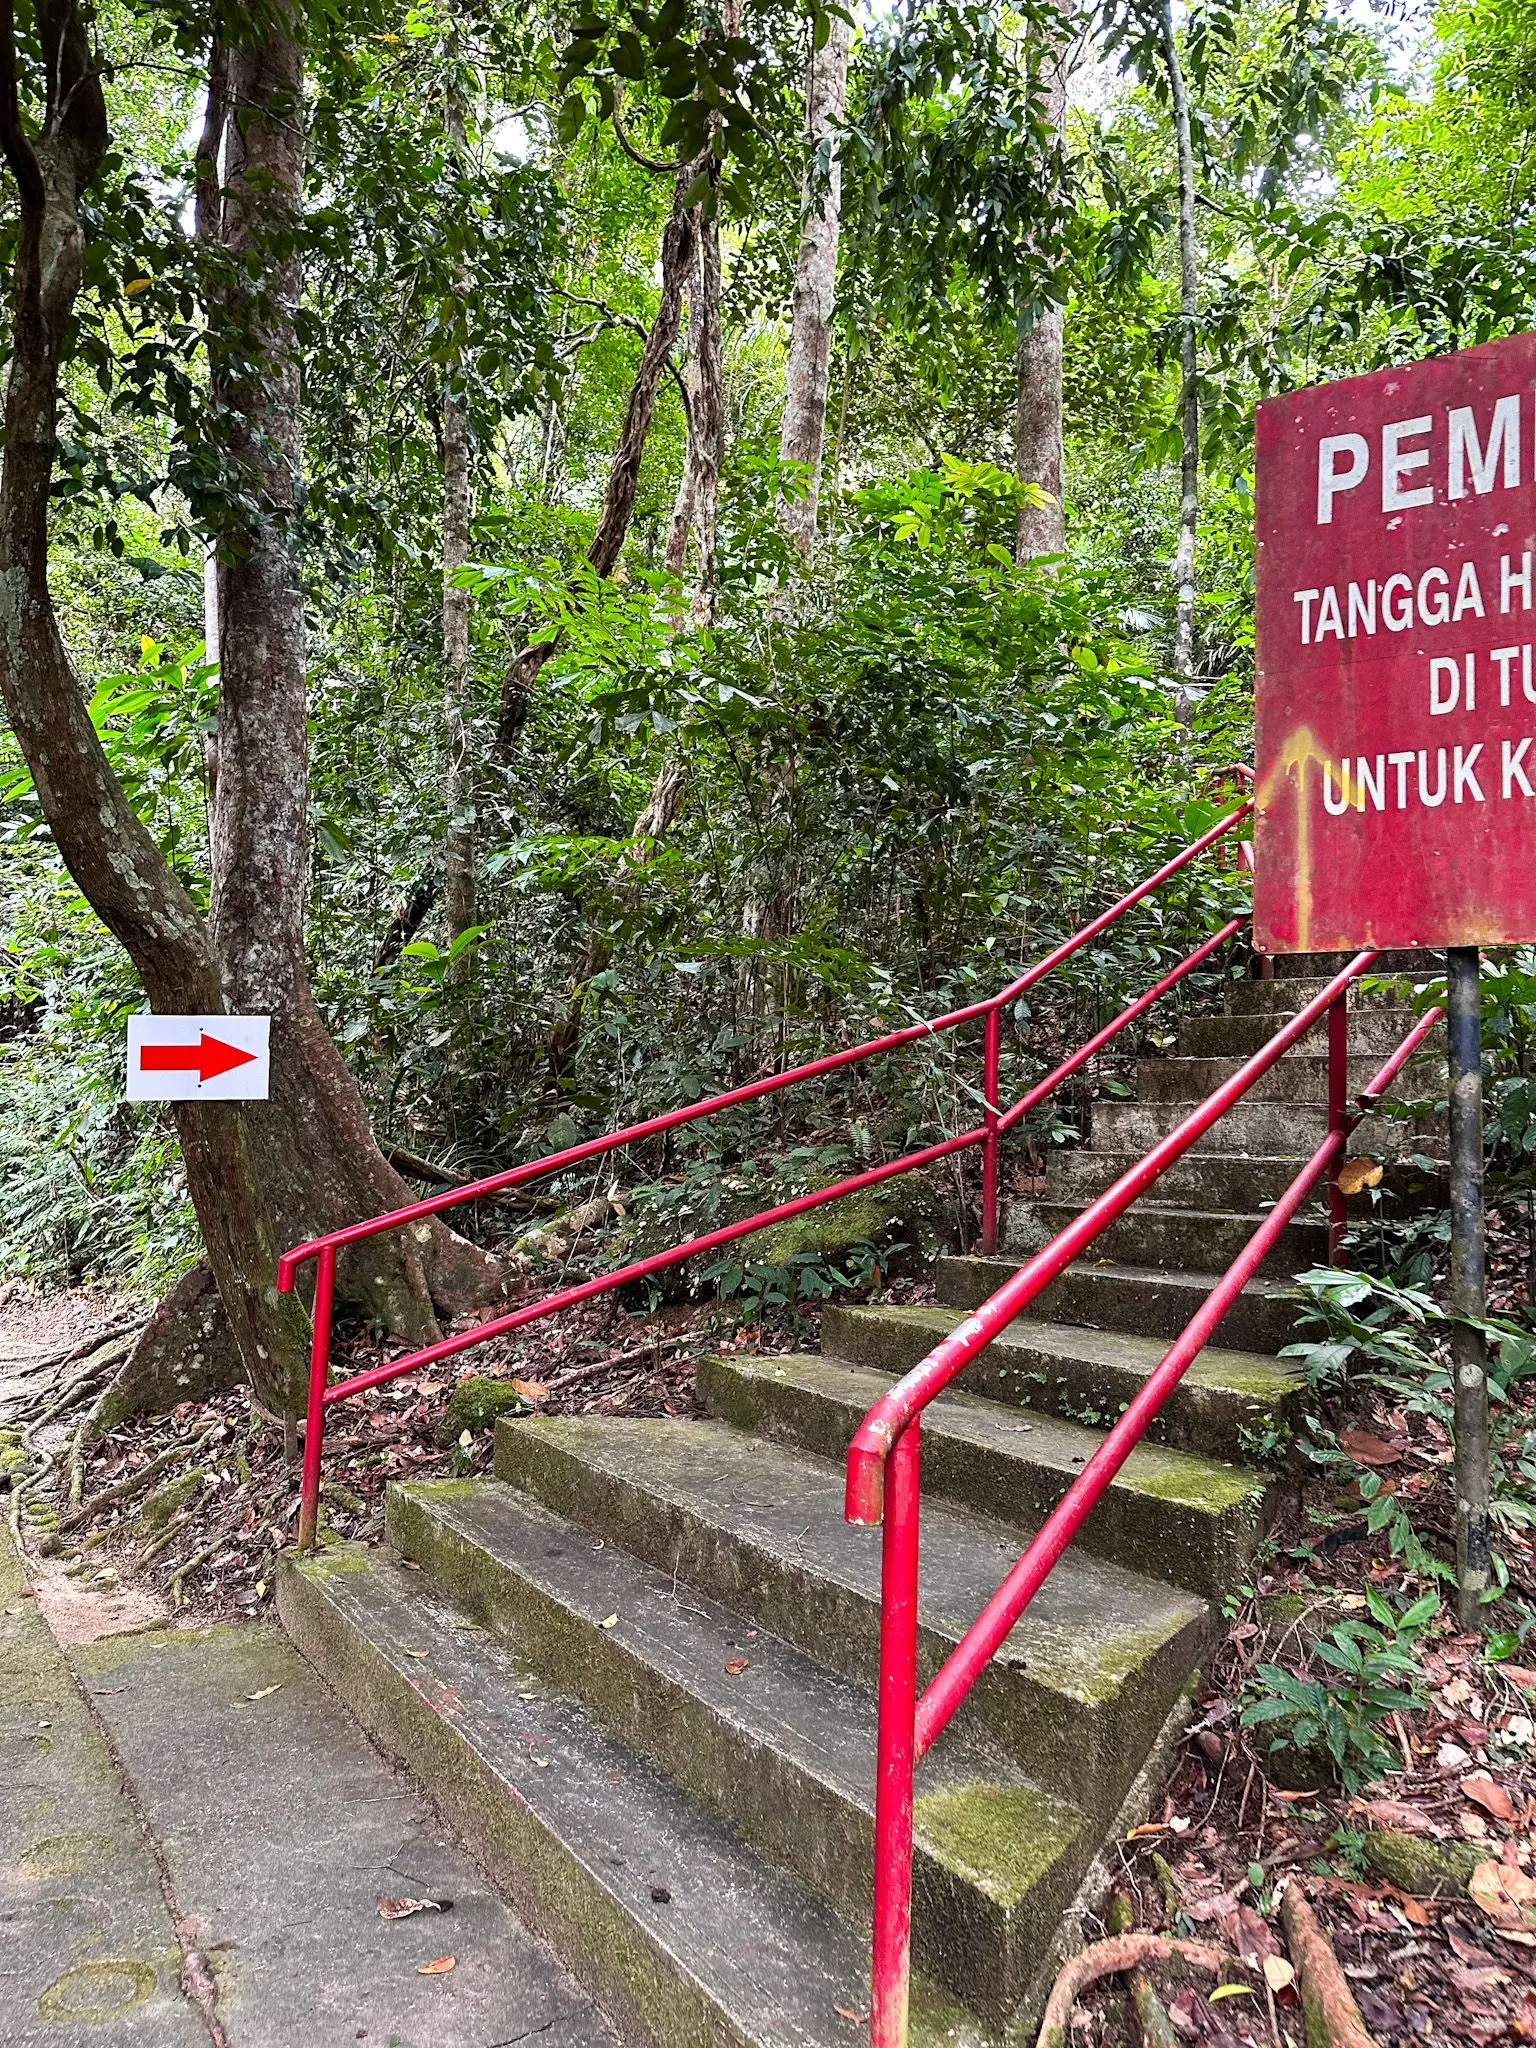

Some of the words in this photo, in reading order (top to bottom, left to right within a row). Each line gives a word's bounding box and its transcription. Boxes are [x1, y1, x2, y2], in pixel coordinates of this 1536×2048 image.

[1317, 390, 1536, 525] PEM
[1294, 561, 1486, 645] TANGGA
[1500, 551, 1532, 614] H
[1429, 653, 1475, 716] DI
[1323, 743, 1486, 815] UNTUK
[1501, 737, 1536, 800] K
